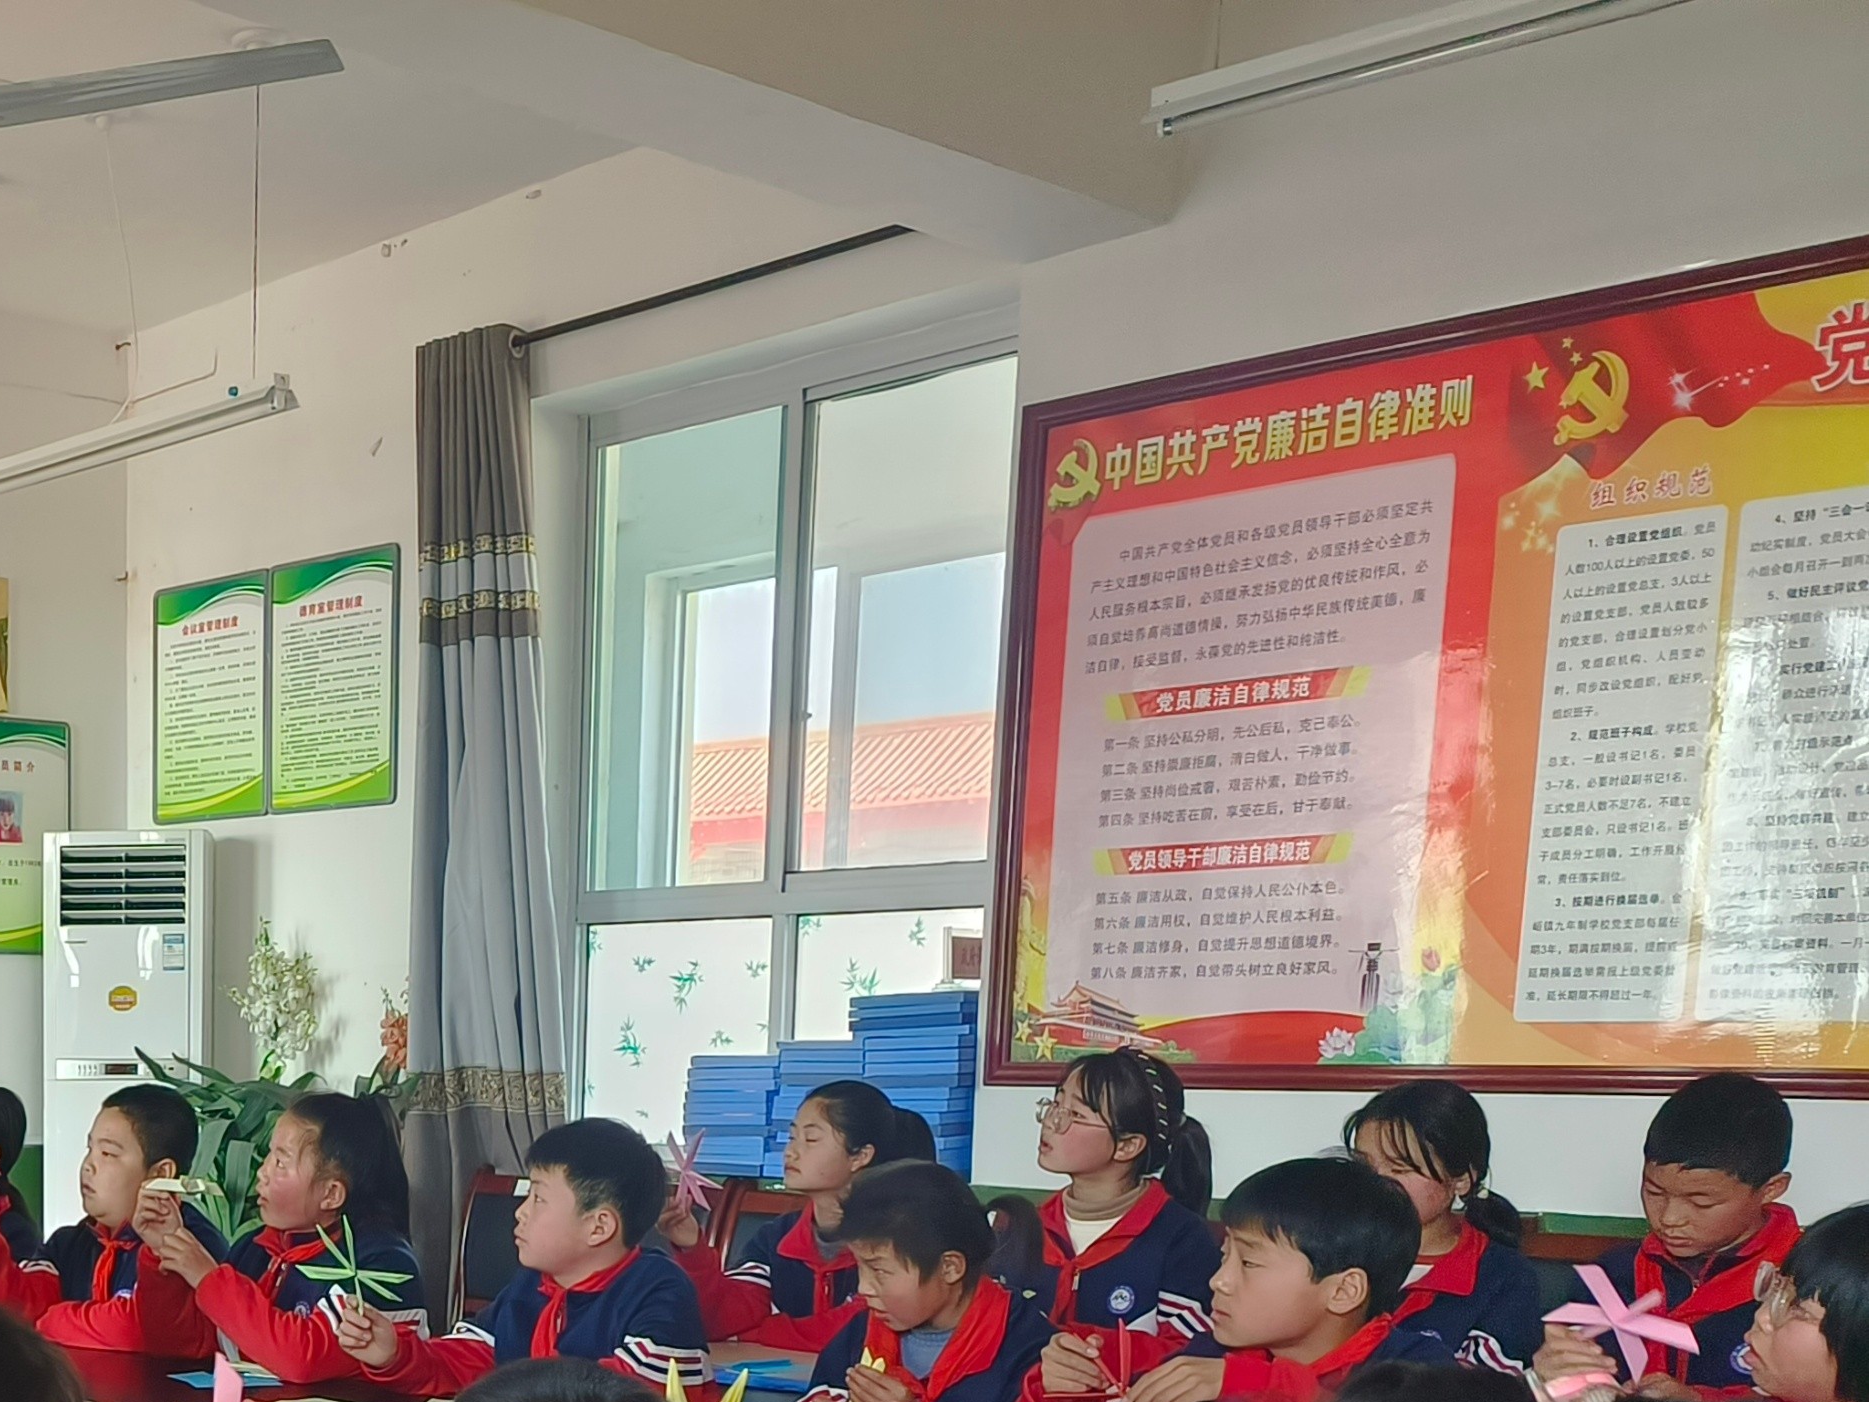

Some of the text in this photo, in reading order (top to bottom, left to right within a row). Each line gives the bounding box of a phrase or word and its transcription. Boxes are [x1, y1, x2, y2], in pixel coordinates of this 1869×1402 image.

[1104, 374, 1474, 490] 中国共产党廉洁自律准则
[1590, 465, 1712, 508] 组织规范
[1156, 676, 1311, 713] 党员廉洁自律规范
[1104, 735, 1140, 753] 第一条
[1102, 763, 1138, 777] 第二条
[1100, 788, 1136, 802] 第三条
[1098, 814, 1134, 828] 第四条
[1128, 840, 1311, 871] 党员领导干部廉洁自律规范
[1095, 891, 1132, 906] 第五条
[1094, 916, 1130, 930] 第六条
[1092, 941, 1128, 955] 第七条
[1090, 965, 1127, 980] 第八条
